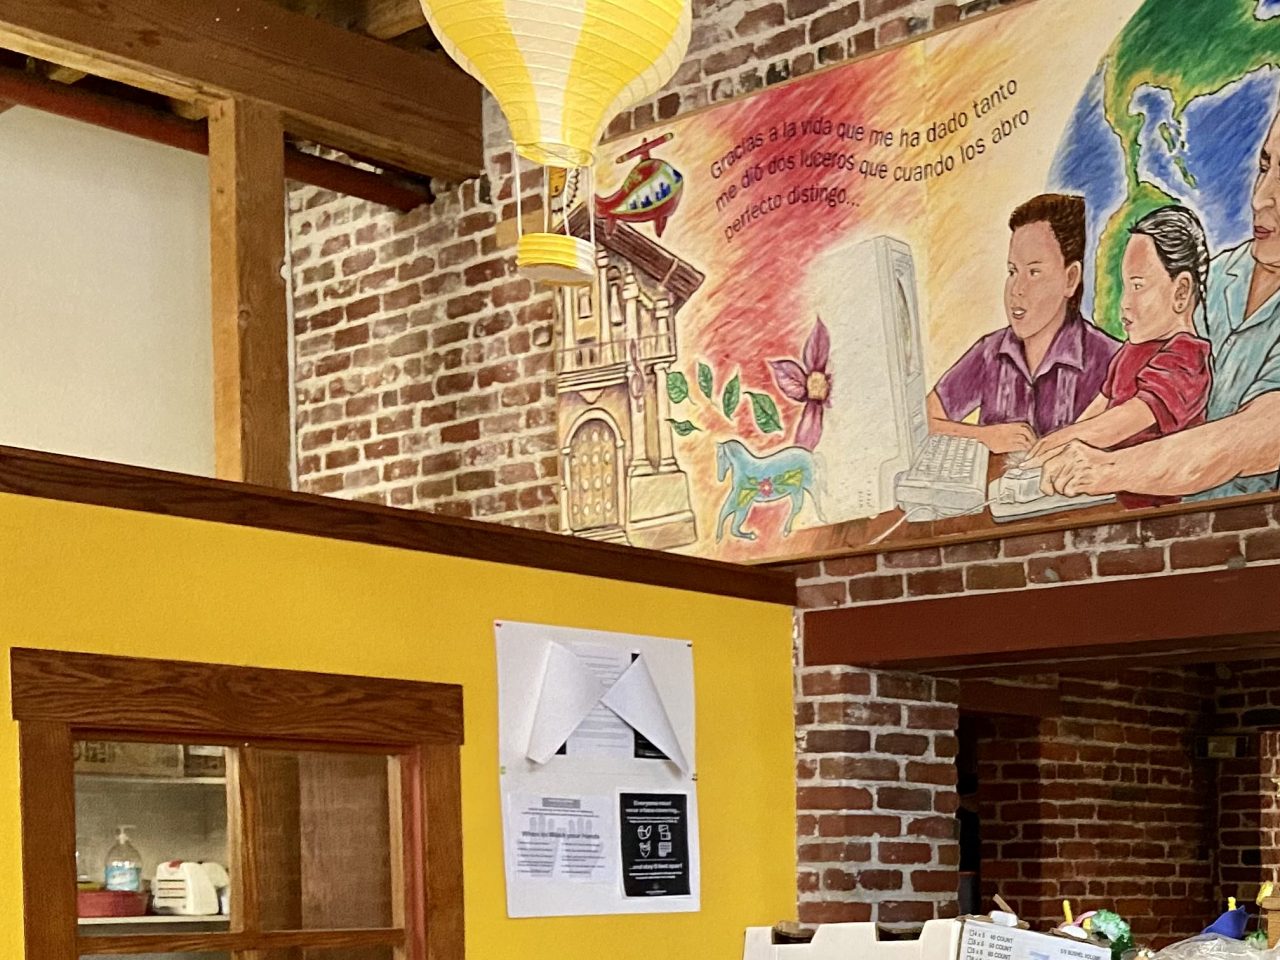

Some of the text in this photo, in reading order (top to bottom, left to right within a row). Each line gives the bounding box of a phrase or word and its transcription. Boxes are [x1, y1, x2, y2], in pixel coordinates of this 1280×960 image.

[710, 79, 1017, 179] Gracias a la vida que me ha dado tanto
[715, 184, 738, 212] me
[768, 153, 795, 174] dos
[800, 149, 854, 171] luceros
[859, 159, 887, 179] que
[894, 153, 954, 181] cuando
[960, 137, 986, 164] los
[992, 109, 1029, 144] abro
[724, 193, 782, 243] perfecto
[994, 952, 1011, 960] COUNT
[997, 935, 1013, 943] COUNT
